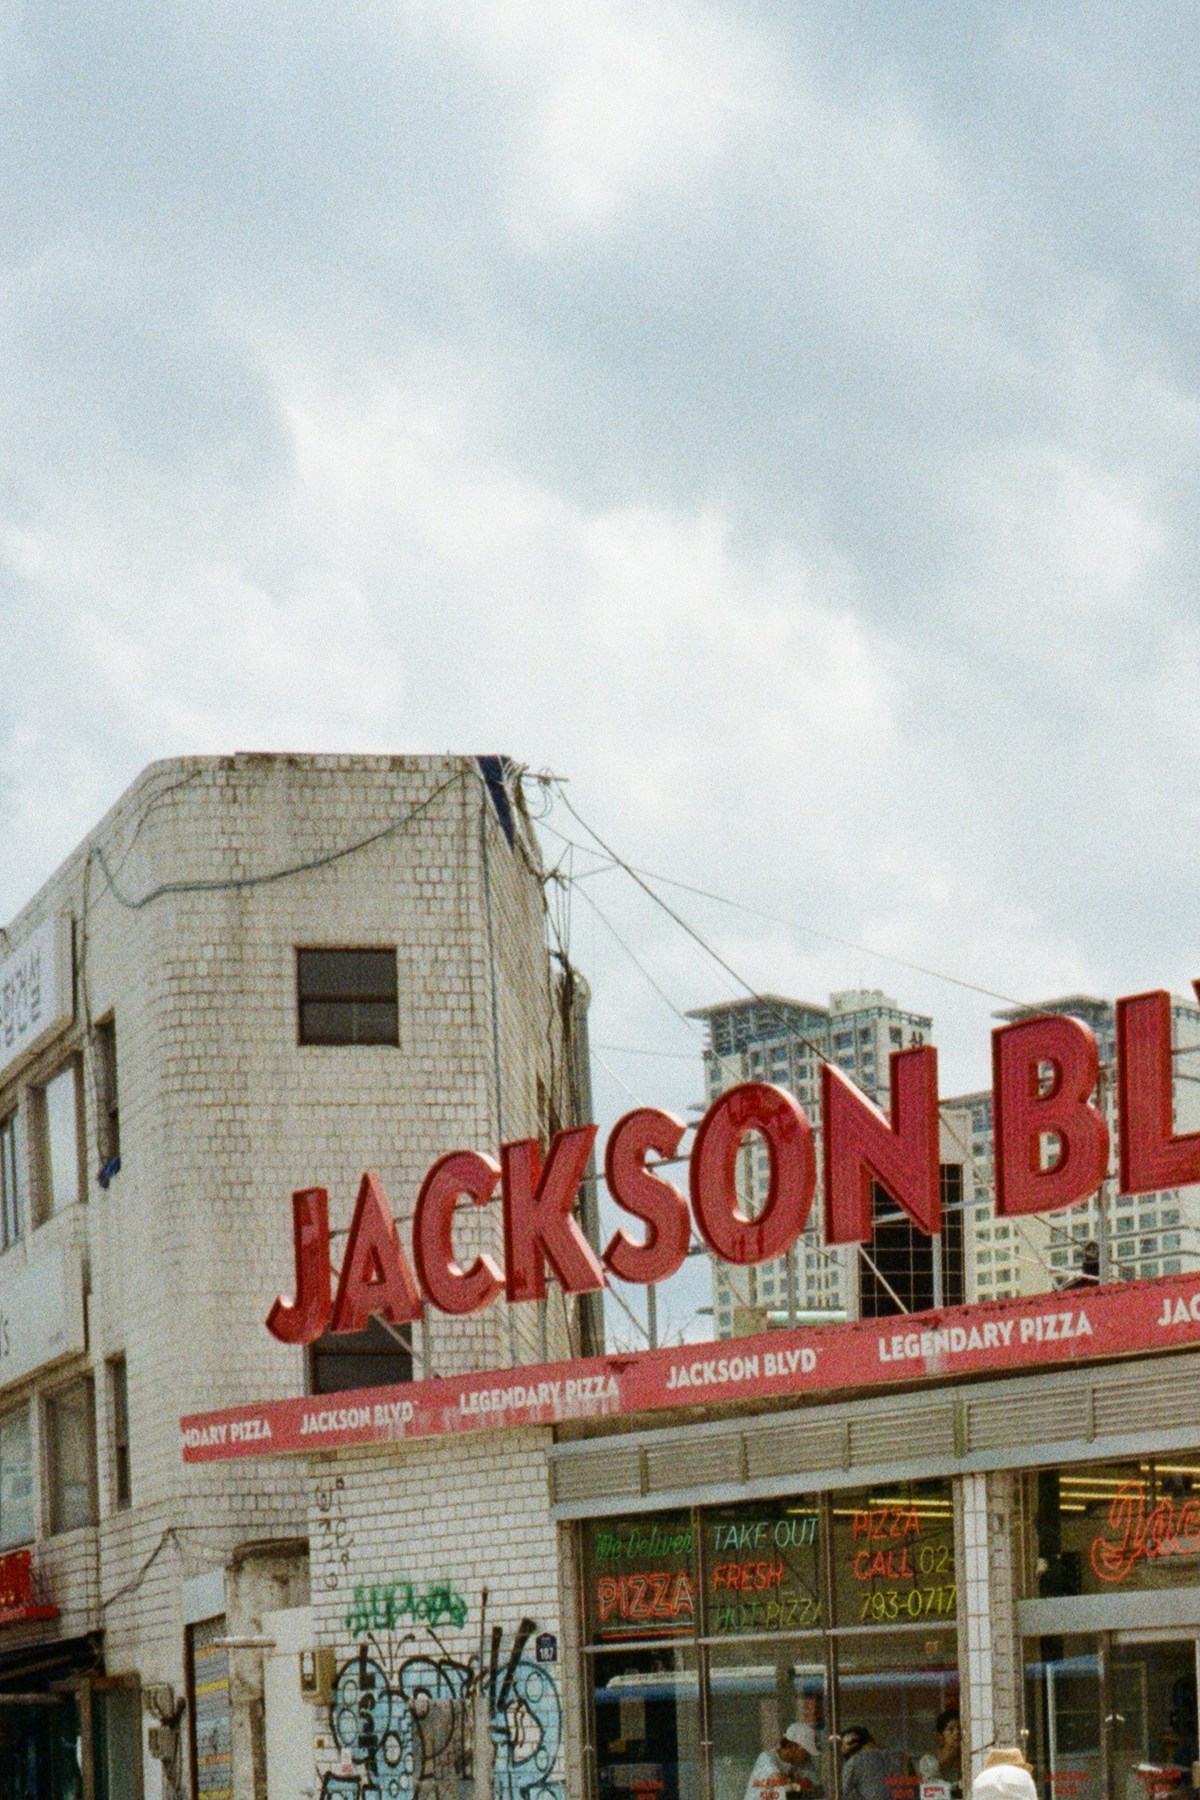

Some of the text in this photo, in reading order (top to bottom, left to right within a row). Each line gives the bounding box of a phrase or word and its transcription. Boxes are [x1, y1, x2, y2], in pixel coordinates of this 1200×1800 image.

[265, 1046, 941, 1345] JACKSON
[230, 1420, 272, 1443] PIZZA
[300, 1407, 371, 1435] JACKSON
[460, 1381, 562, 1414] LEGENDARY
[566, 1375, 620, 1402] PIZZA
[666, 1354, 759, 1389] JACKSON
[879, 1321, 1017, 1362] LEGENDARY
[1021, 1311, 1093, 1343] PIZZA
[713, 1517, 820, 1551] TAKE OUT
[853, 1507, 923, 1541] PIZZA
[712, 1561, 785, 1592] FRESH
[854, 1547, 914, 1581] CALL
[597, 1570, 696, 1620] PIZZA
